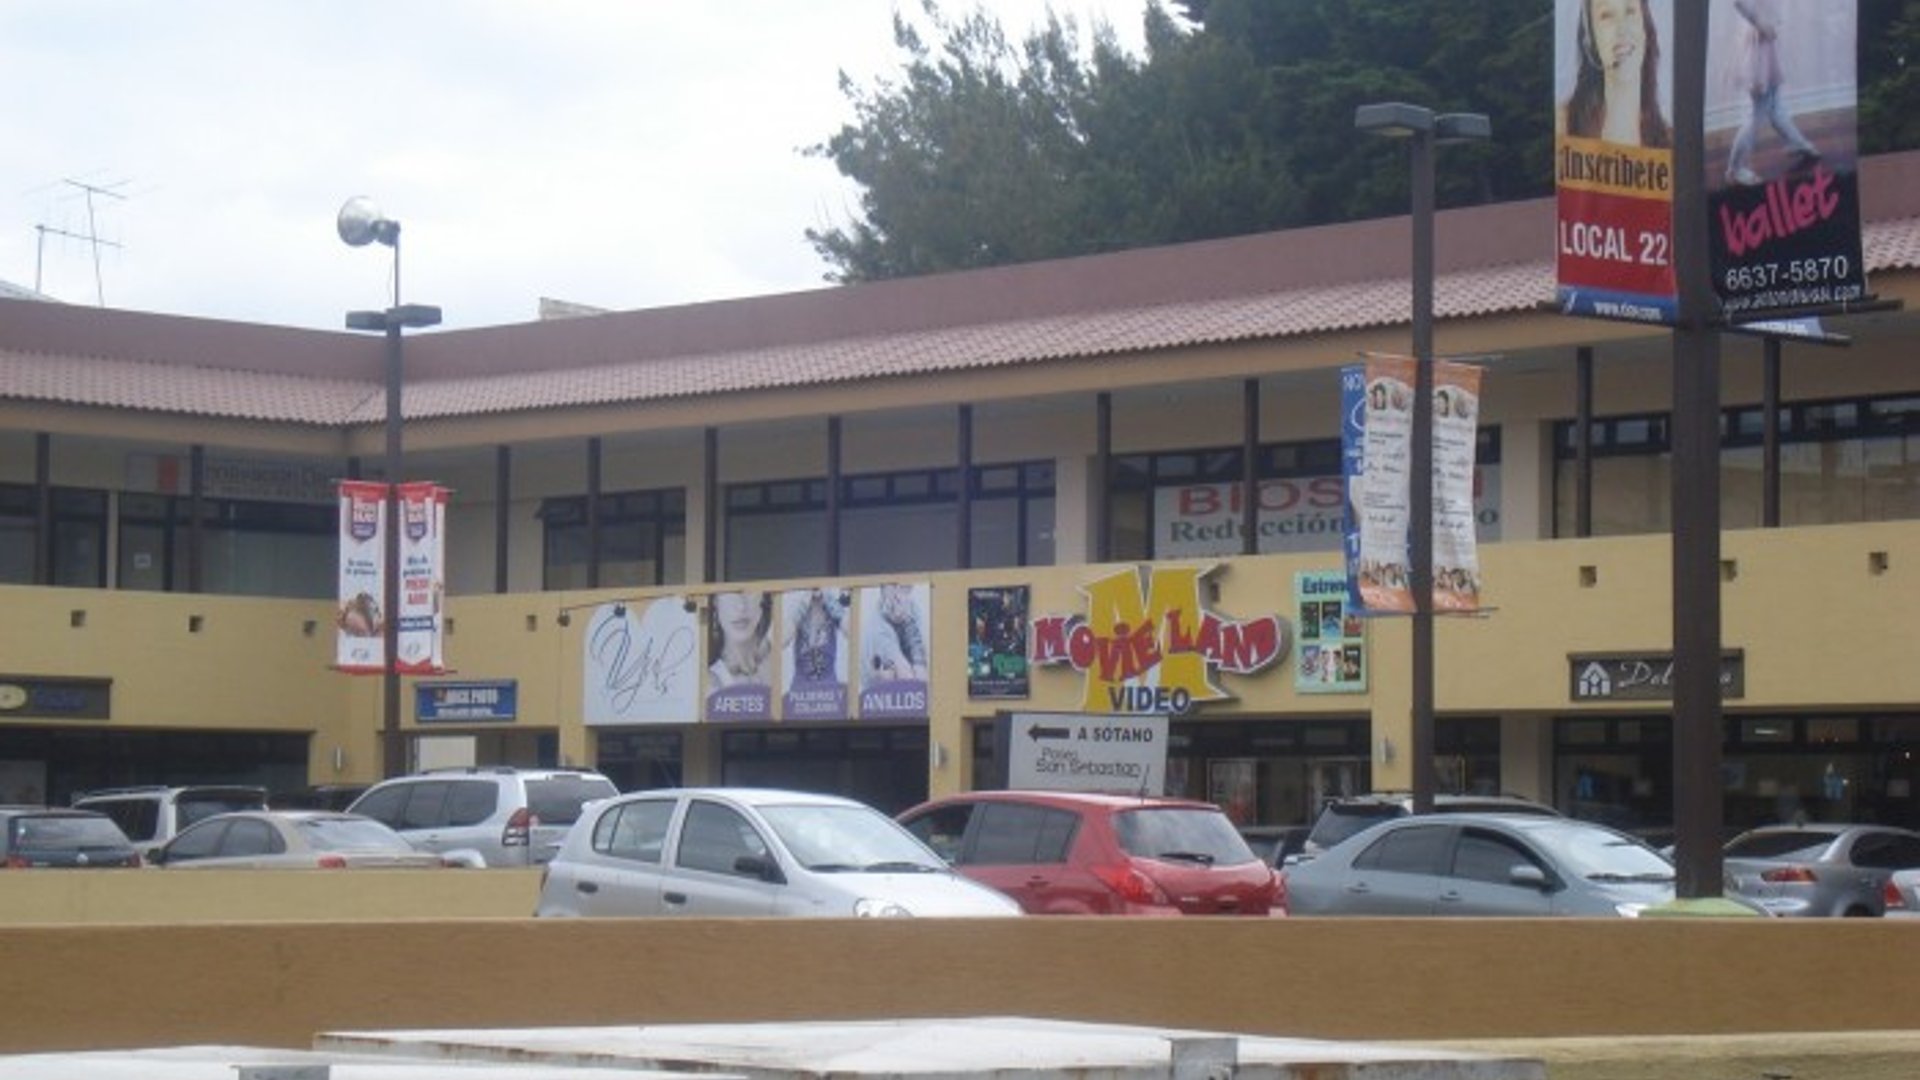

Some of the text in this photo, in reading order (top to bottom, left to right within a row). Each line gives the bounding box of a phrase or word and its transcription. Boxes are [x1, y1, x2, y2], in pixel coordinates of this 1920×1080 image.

[1719, 165, 1840, 256] ballet
[1560, 219, 1668, 266] LOCAL 22
[1726, 256, 1849, 291] 6637-5870
[1170, 512, 1345, 541] Redcción
[1302, 576, 1347, 594] Estren
[1165, 609, 1282, 674] LAND
[714, 697, 764, 713] ARETES
[863, 691, 926, 711] ANILLOS
[1109, 686, 1191, 712] VIDEO
[1077, 727, 1154, 743] A SOTANO
